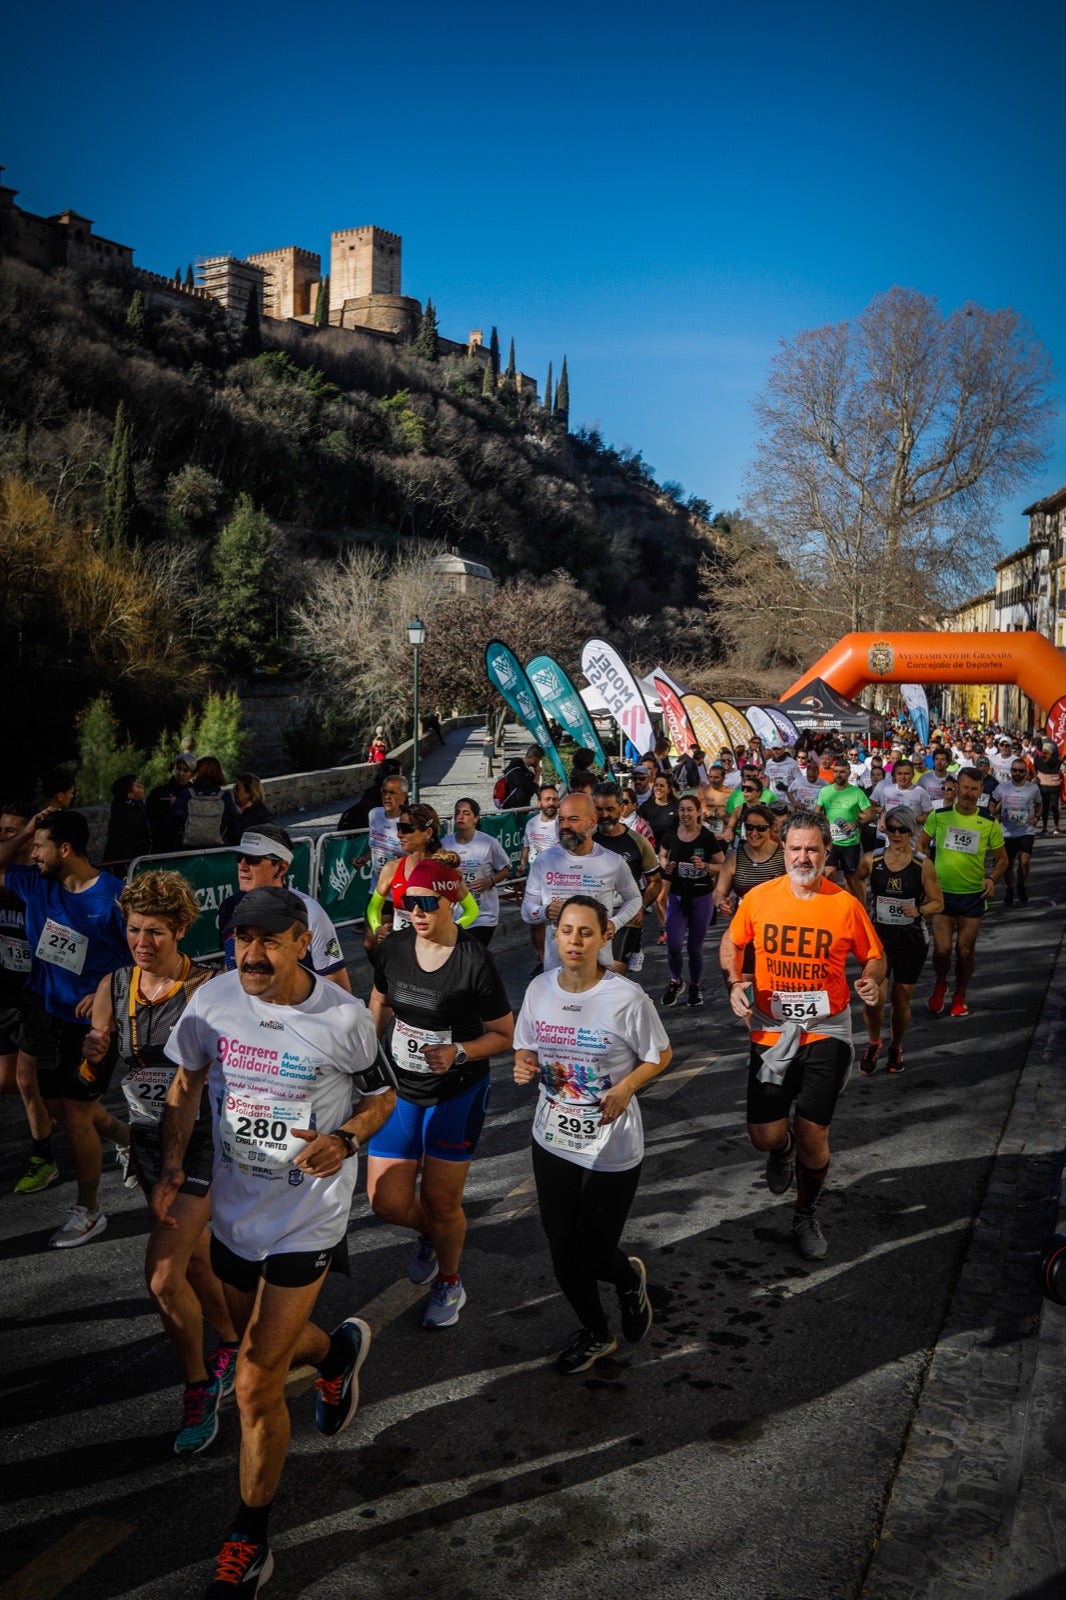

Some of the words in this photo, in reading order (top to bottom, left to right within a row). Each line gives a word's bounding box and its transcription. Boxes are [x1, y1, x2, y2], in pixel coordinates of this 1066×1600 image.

[953, 661, 964, 669] de
[966, 661, 1003, 669] Deportes
[954, 834, 972, 845] 145
[546, 871, 554, 886] 9
[554, 872, 581, 880] Carrera
[49, 934, 77, 954] 274
[763, 923, 833, 960] BEER
[7, 946, 31, 960] 138
[766, 957, 829, 980] RUNNERS
[782, 1002, 818, 1018] 554
[259, 1020, 285, 1031] Altium
[540, 1021, 575, 1035] Carrera
[216, 1036, 229, 1063] 9
[230, 1038, 279, 1061] Carrera
[576, 1041, 607, 1050] Granado
[282, 1052, 299, 1062] Ave
[227, 1053, 280, 1076] Solidaria
[281, 1061, 307, 1072] María
[134, 1075, 169, 1084] Solidaria
[136, 1070, 167, 1078] Carrera
[280, 1069, 318, 1081] Granado
[227, 1095, 236, 1110] 9
[236, 1098, 270, 1112] Carrera
[235, 1106, 272, 1119] Solidaria
[236, 1116, 287, 1141] 280
[558, 1114, 596, 1134] 293
[236, 1137, 257, 1147] CARLA
[264, 1142, 288, 1151] MATEO
[252, 1165, 273, 1175] REAL
